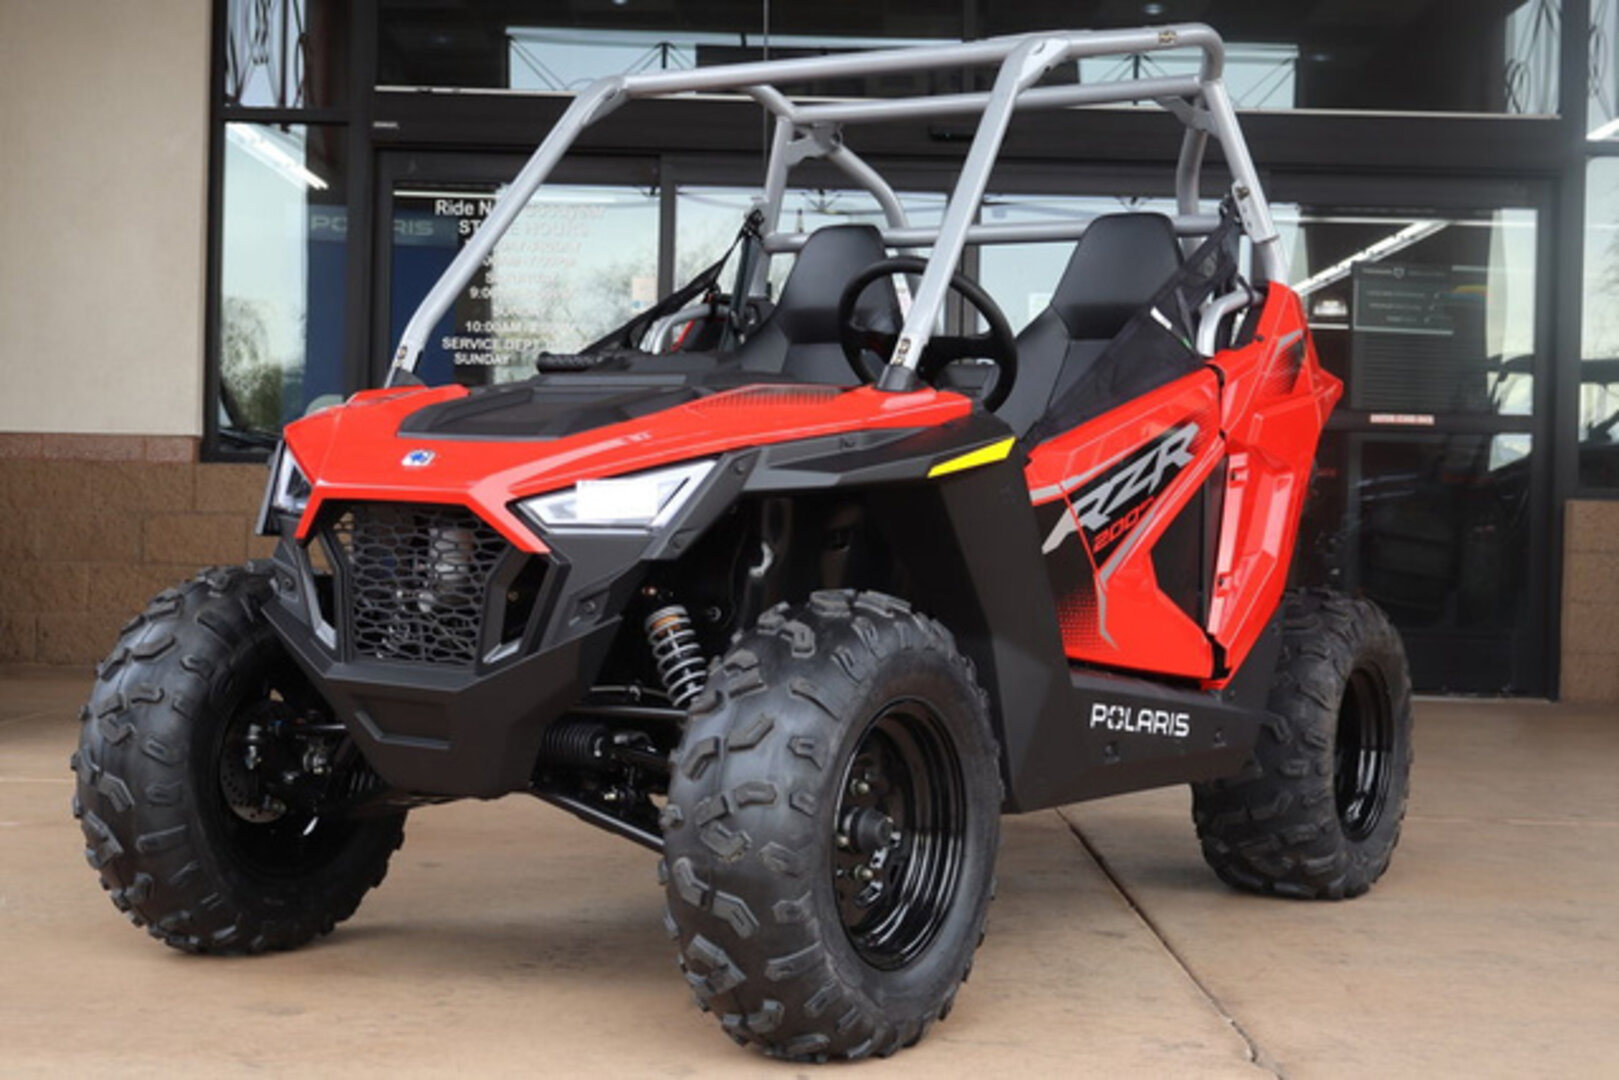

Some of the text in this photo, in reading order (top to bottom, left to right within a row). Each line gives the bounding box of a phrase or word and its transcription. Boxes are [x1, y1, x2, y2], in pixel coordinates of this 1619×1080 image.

[434, 199, 475, 216] Ride
[441, 337, 500, 350] SERVICE
[453, 352, 511, 366] SUNDAY
[1042, 422, 1199, 555] RZR
[1089, 702, 1190, 738] POLARIS
